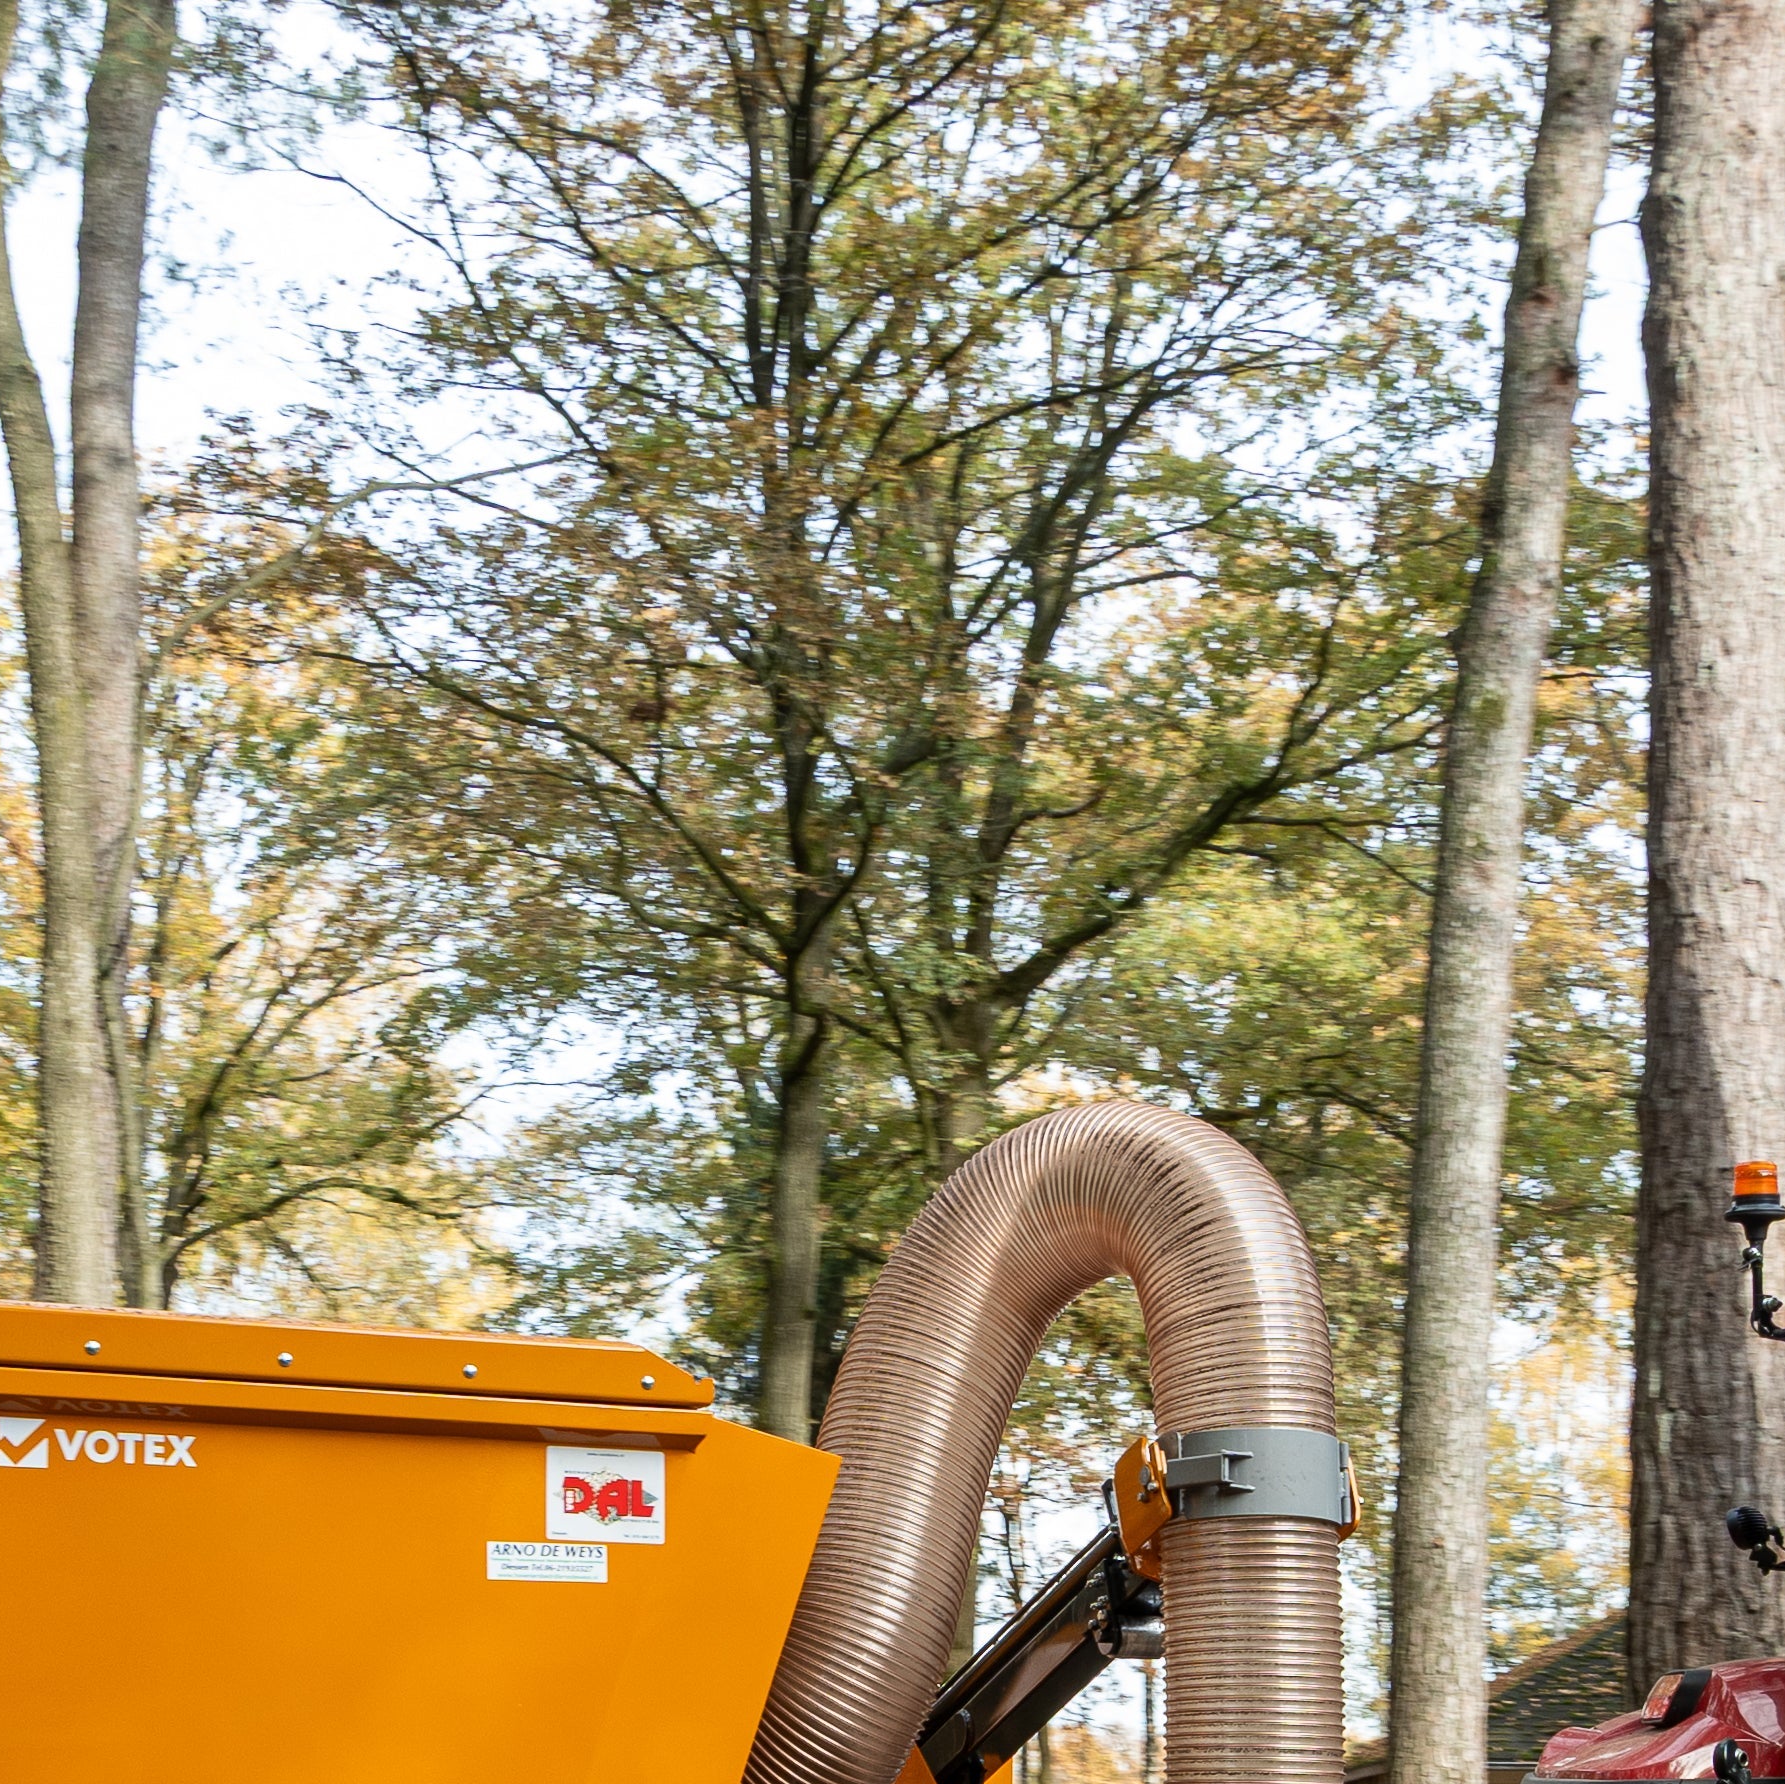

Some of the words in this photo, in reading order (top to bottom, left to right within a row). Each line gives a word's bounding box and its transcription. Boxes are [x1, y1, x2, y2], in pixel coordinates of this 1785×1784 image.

[53, 1428, 198, 1468] VOTEX
[562, 1476, 655, 1521] DAL
[492, 1543, 536, 1557] ARNO
[540, 1544, 561, 1557] DE
[565, 1545, 604, 1559] WEYS
